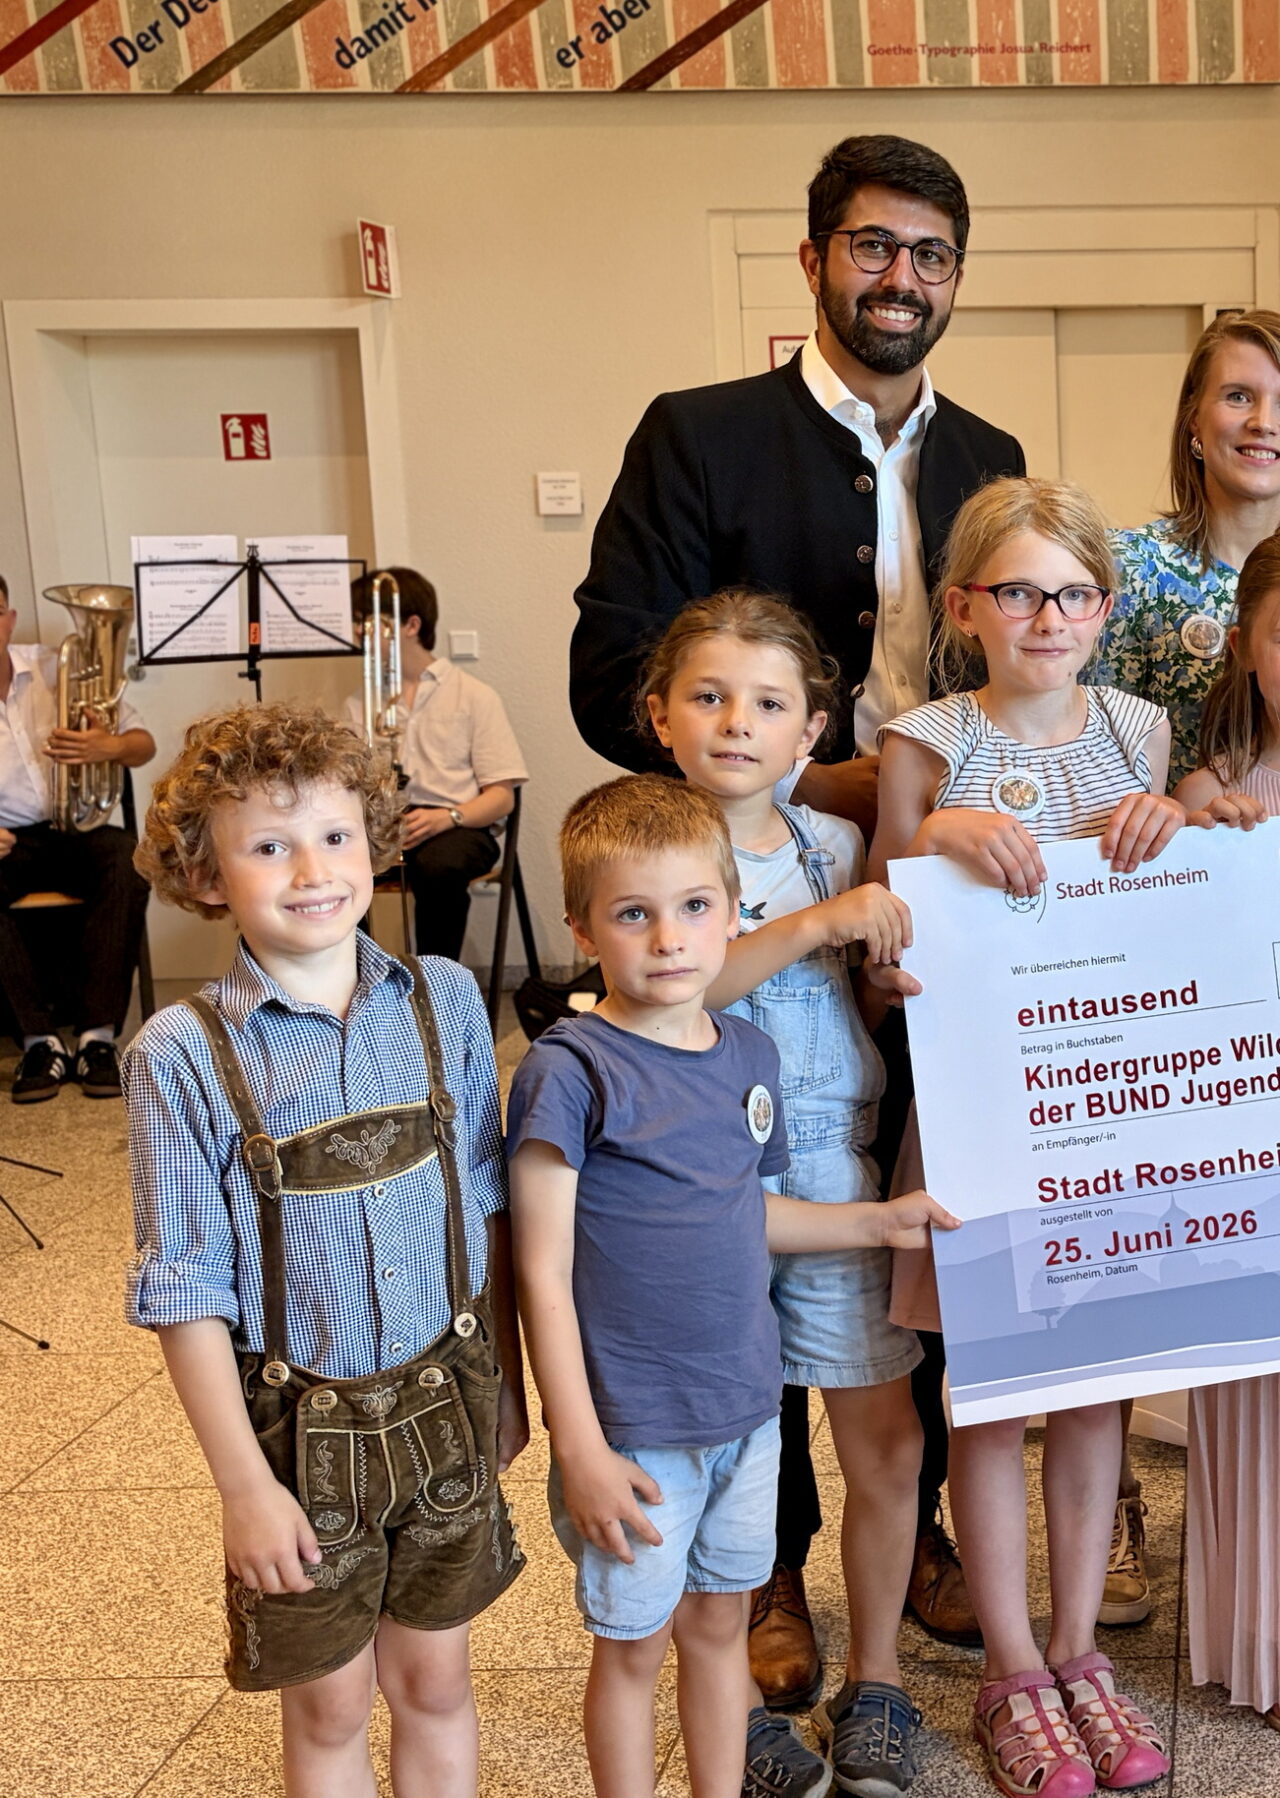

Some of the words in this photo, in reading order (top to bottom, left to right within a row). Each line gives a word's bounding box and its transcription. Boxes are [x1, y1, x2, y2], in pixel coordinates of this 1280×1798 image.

[109, 20, 164, 69] Der
[161, 0, 219, 29] De
[335, 0, 416, 69] damit
[1001, 42, 1035, 54] Josua
[1039, 41, 1092, 53] Reichert
[556, 35, 585, 69] er
[1056, 878, 1105, 900] Stadt
[1109, 867, 1209, 893] Rosenheim
[1011, 965, 1028, 976] Wir
[1030, 958, 1089, 974] überreichen
[1091, 953, 1127, 966] hiermit
[1017, 980, 1199, 1027] eintausend
[1020, 1043, 1053, 1056] Betrag
[1055, 1041, 1065, 1051] in
[1066, 1033, 1124, 1049] Buchstaben
[1024, 1046, 1222, 1092] Kindergruppe
[1028, 1100, 1076, 1127] der
[1086, 1083, 1171, 1119] BUND
[1031, 1142, 1044, 1152] an
[1046, 1131, 1117, 1150] Empfänger/-in
[1037, 1167, 1125, 1203] Stadt
[1040, 1209, 1093, 1226] ausgestellt
[1094, 1207, 1114, 1218] von
[1044, 1236, 1091, 1266] 25.
[1104, 1222, 1173, 1257] Juni
[1183, 1209, 1258, 1245] 2026
[1047, 1269, 1104, 1285] Rosenheim,
[1105, 1263, 1139, 1277] Datum
